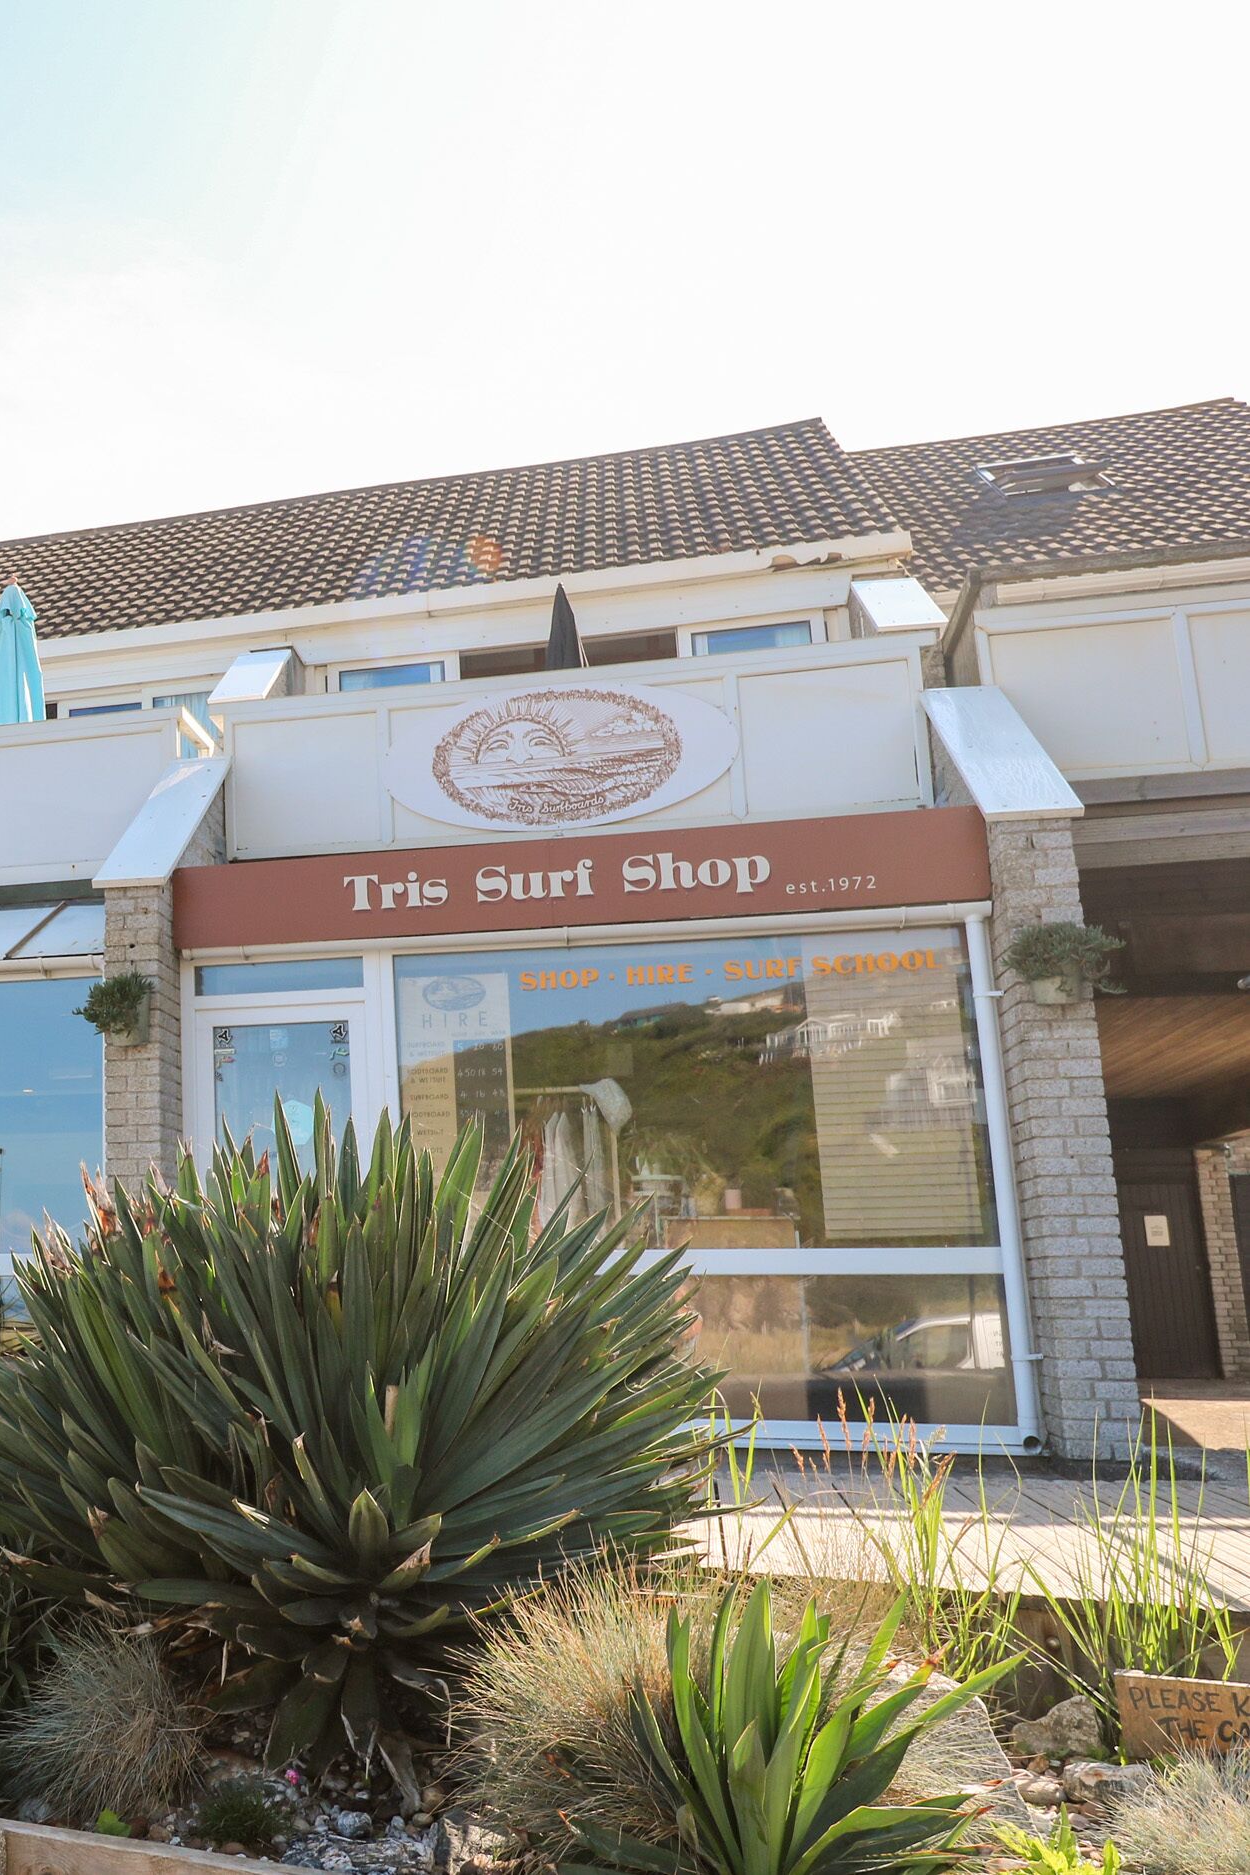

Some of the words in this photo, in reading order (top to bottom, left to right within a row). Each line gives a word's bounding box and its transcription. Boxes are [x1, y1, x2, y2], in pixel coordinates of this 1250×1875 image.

[508, 800, 533, 813] Tris
[540, 795, 605, 814] Surfboards
[343, 871, 448, 912] Tris
[475, 859, 594, 903] Surf
[621, 853, 771, 893] Shop
[785, 875, 877, 896] est.1972
[519, 967, 599, 991] SHOP
[626, 963, 694, 986] HIRE
[724, 957, 802, 981] SURF
[812, 948, 943, 977] SCHOOL
[422, 1011, 488, 1029] HIRE
[1129, 1686, 1222, 1713] PLEASE
[1157, 1716, 1207, 1741] THE
